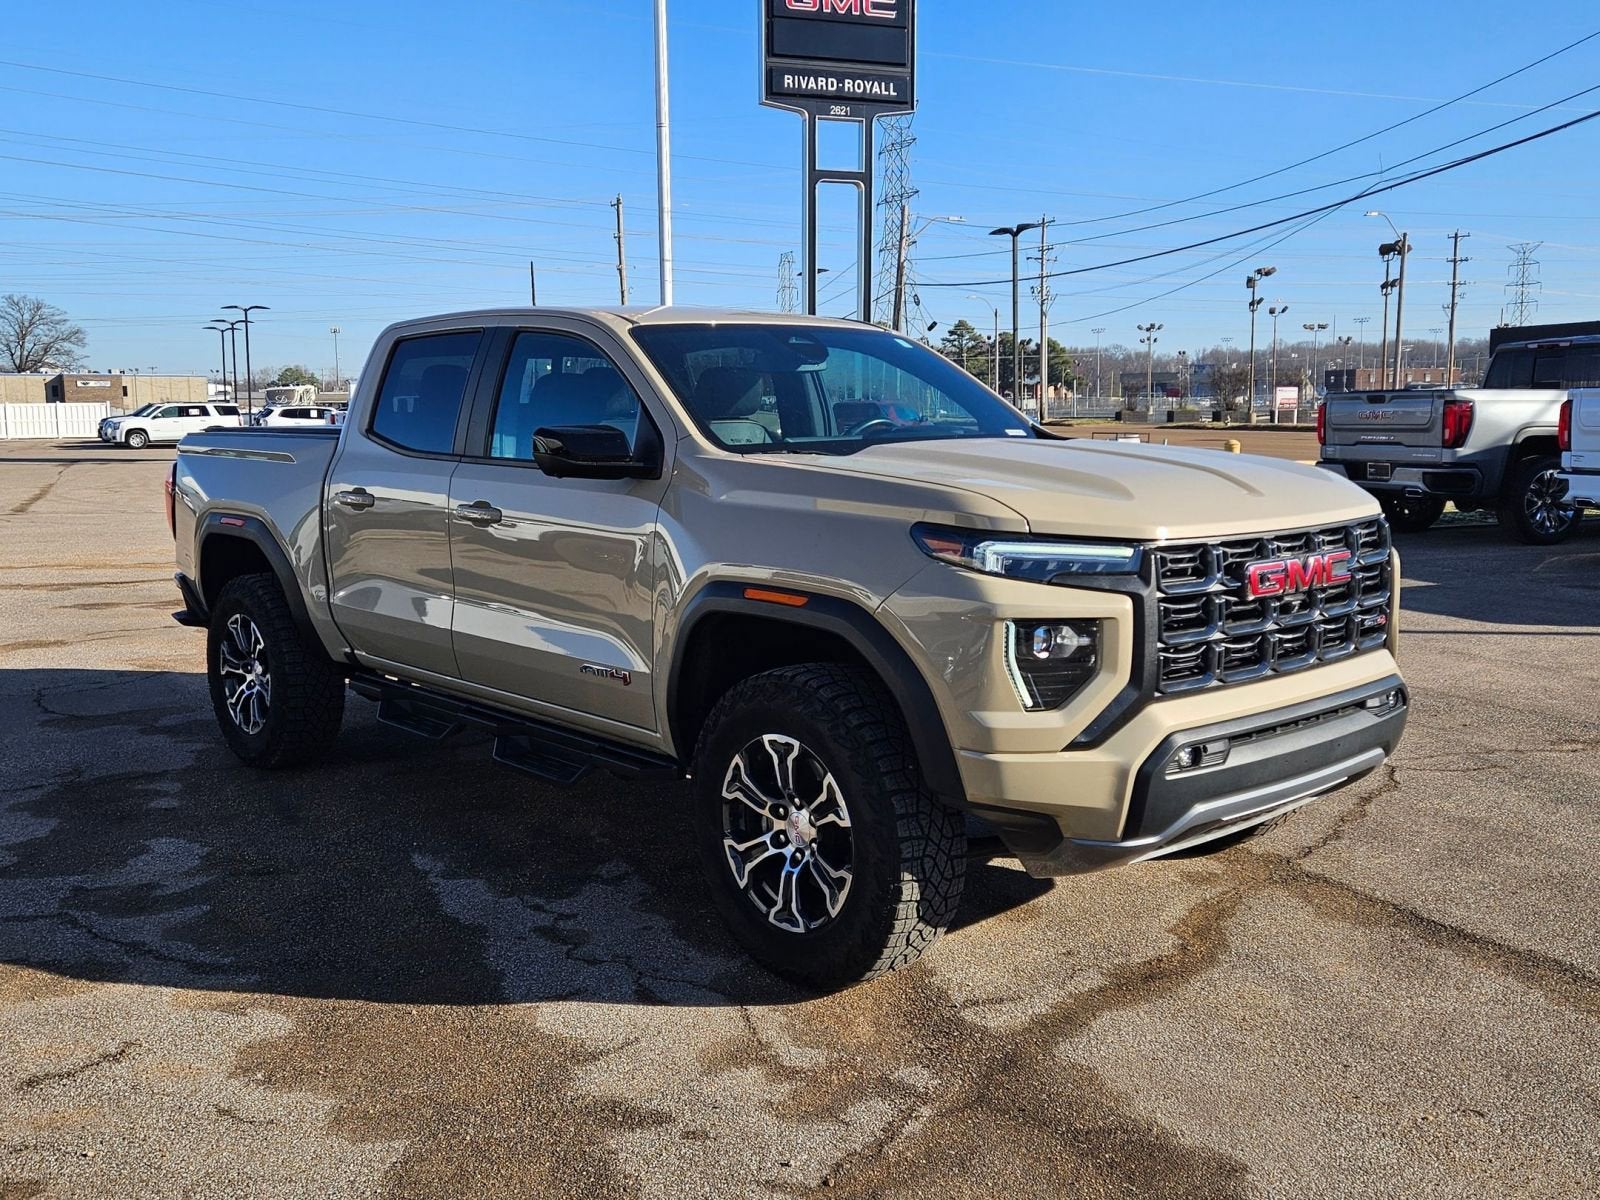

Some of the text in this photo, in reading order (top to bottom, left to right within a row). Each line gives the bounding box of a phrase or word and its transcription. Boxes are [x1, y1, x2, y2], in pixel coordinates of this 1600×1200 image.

[785, 0, 898, 19] GMC
[784, 74, 898, 96] RIVARD-ROYALL
[830, 105, 851, 116] 2621
[1247, 549, 1352, 600] GMC
